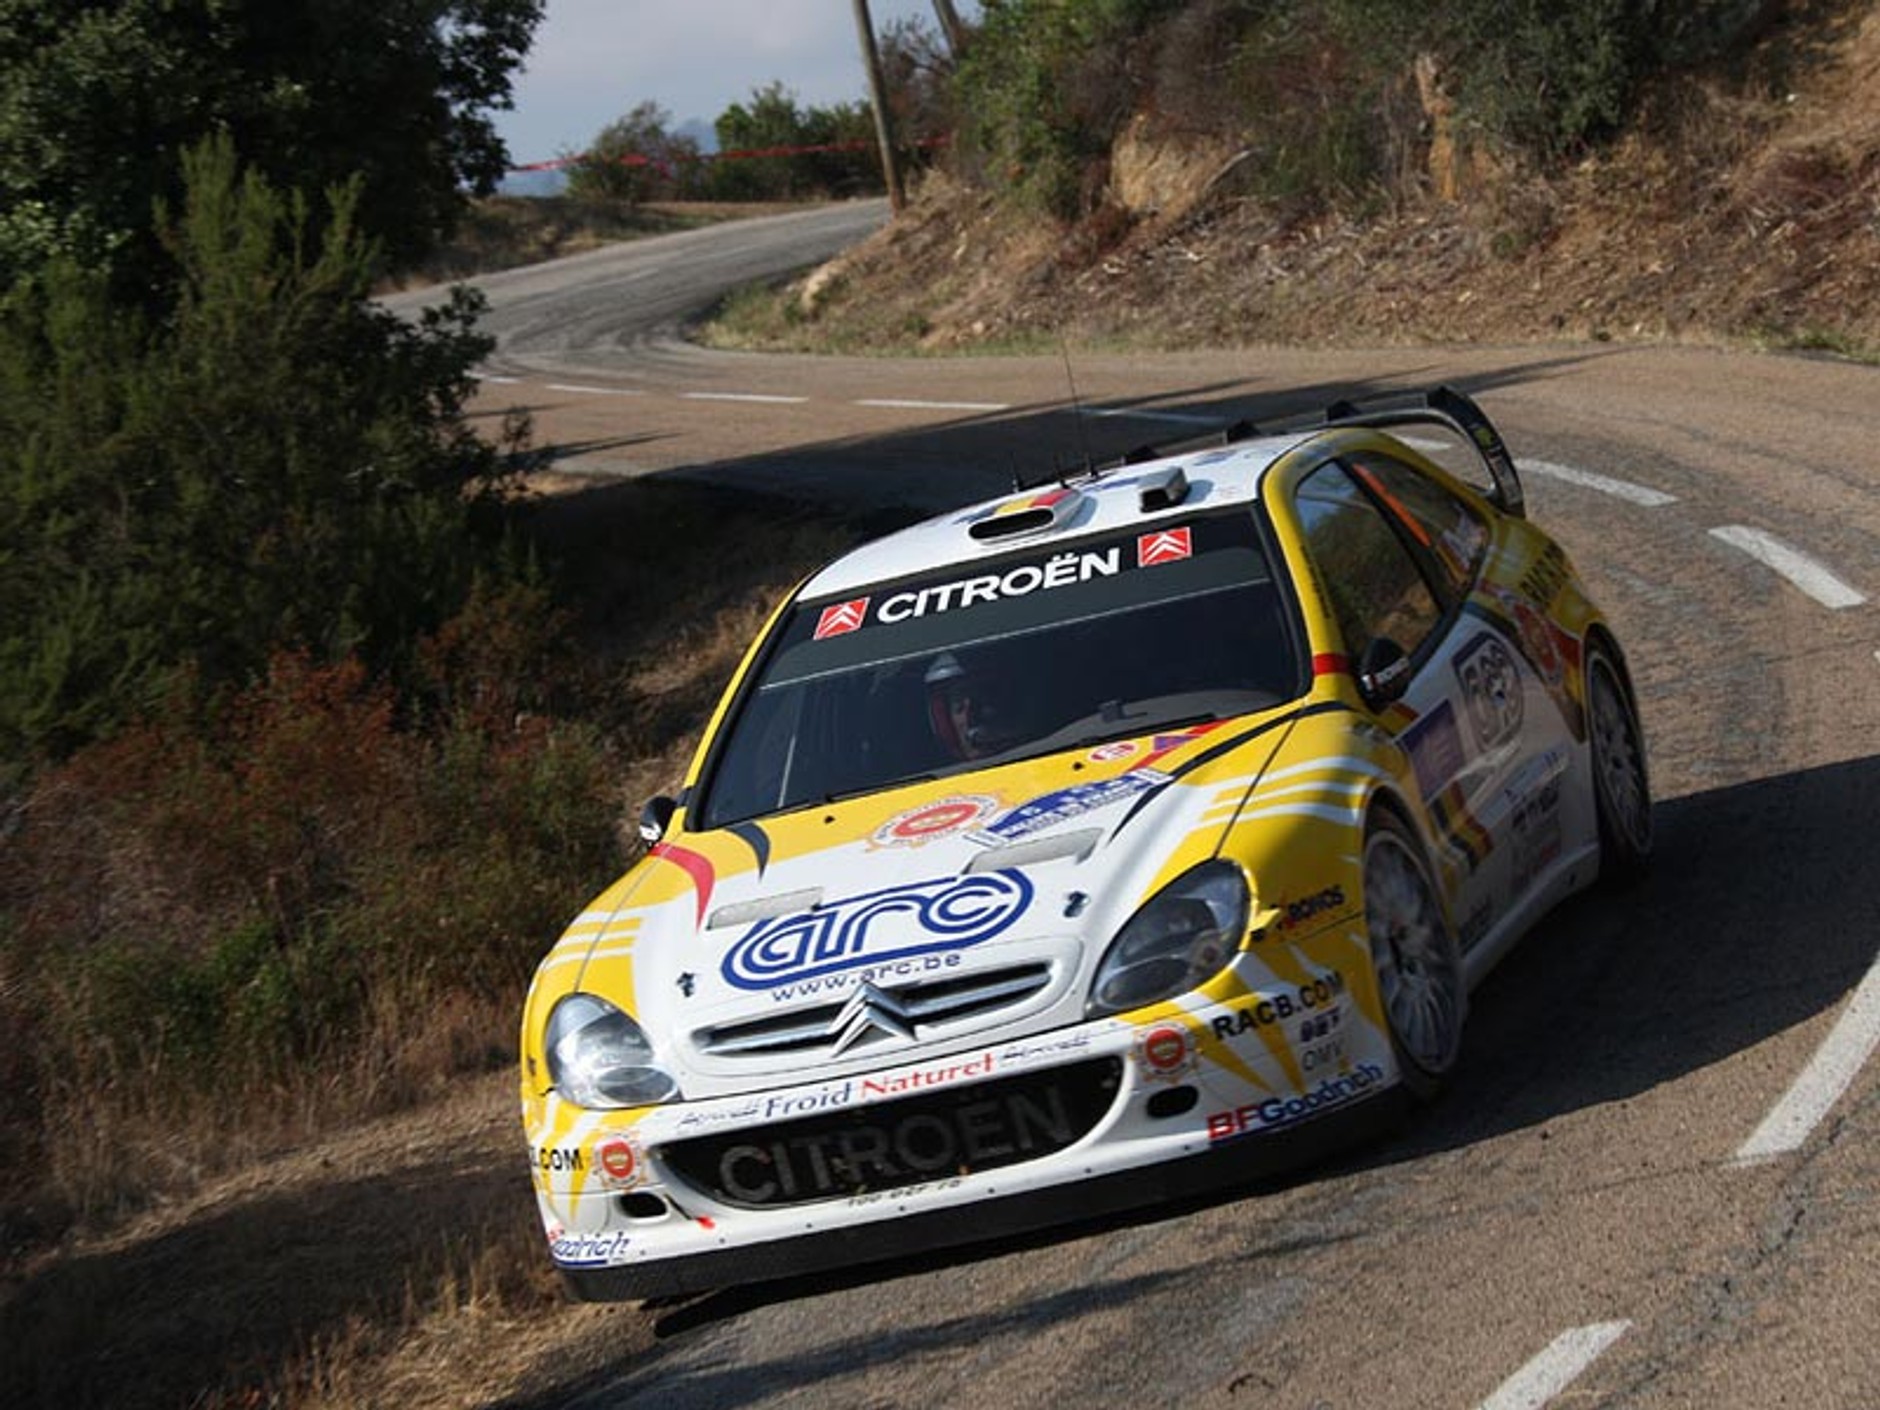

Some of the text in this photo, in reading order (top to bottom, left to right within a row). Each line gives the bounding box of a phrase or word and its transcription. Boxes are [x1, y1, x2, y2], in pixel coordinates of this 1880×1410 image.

[877, 548, 1120, 623] CITROËN
[771, 952, 961, 1002] www.arc.be
[1211, 970, 1345, 1041] RACB.COM
[763, 1083, 852, 1118] Froid
[1207, 1063, 1383, 1139] BFGoodrich
[719, 1087, 1073, 1201] CITROËN
